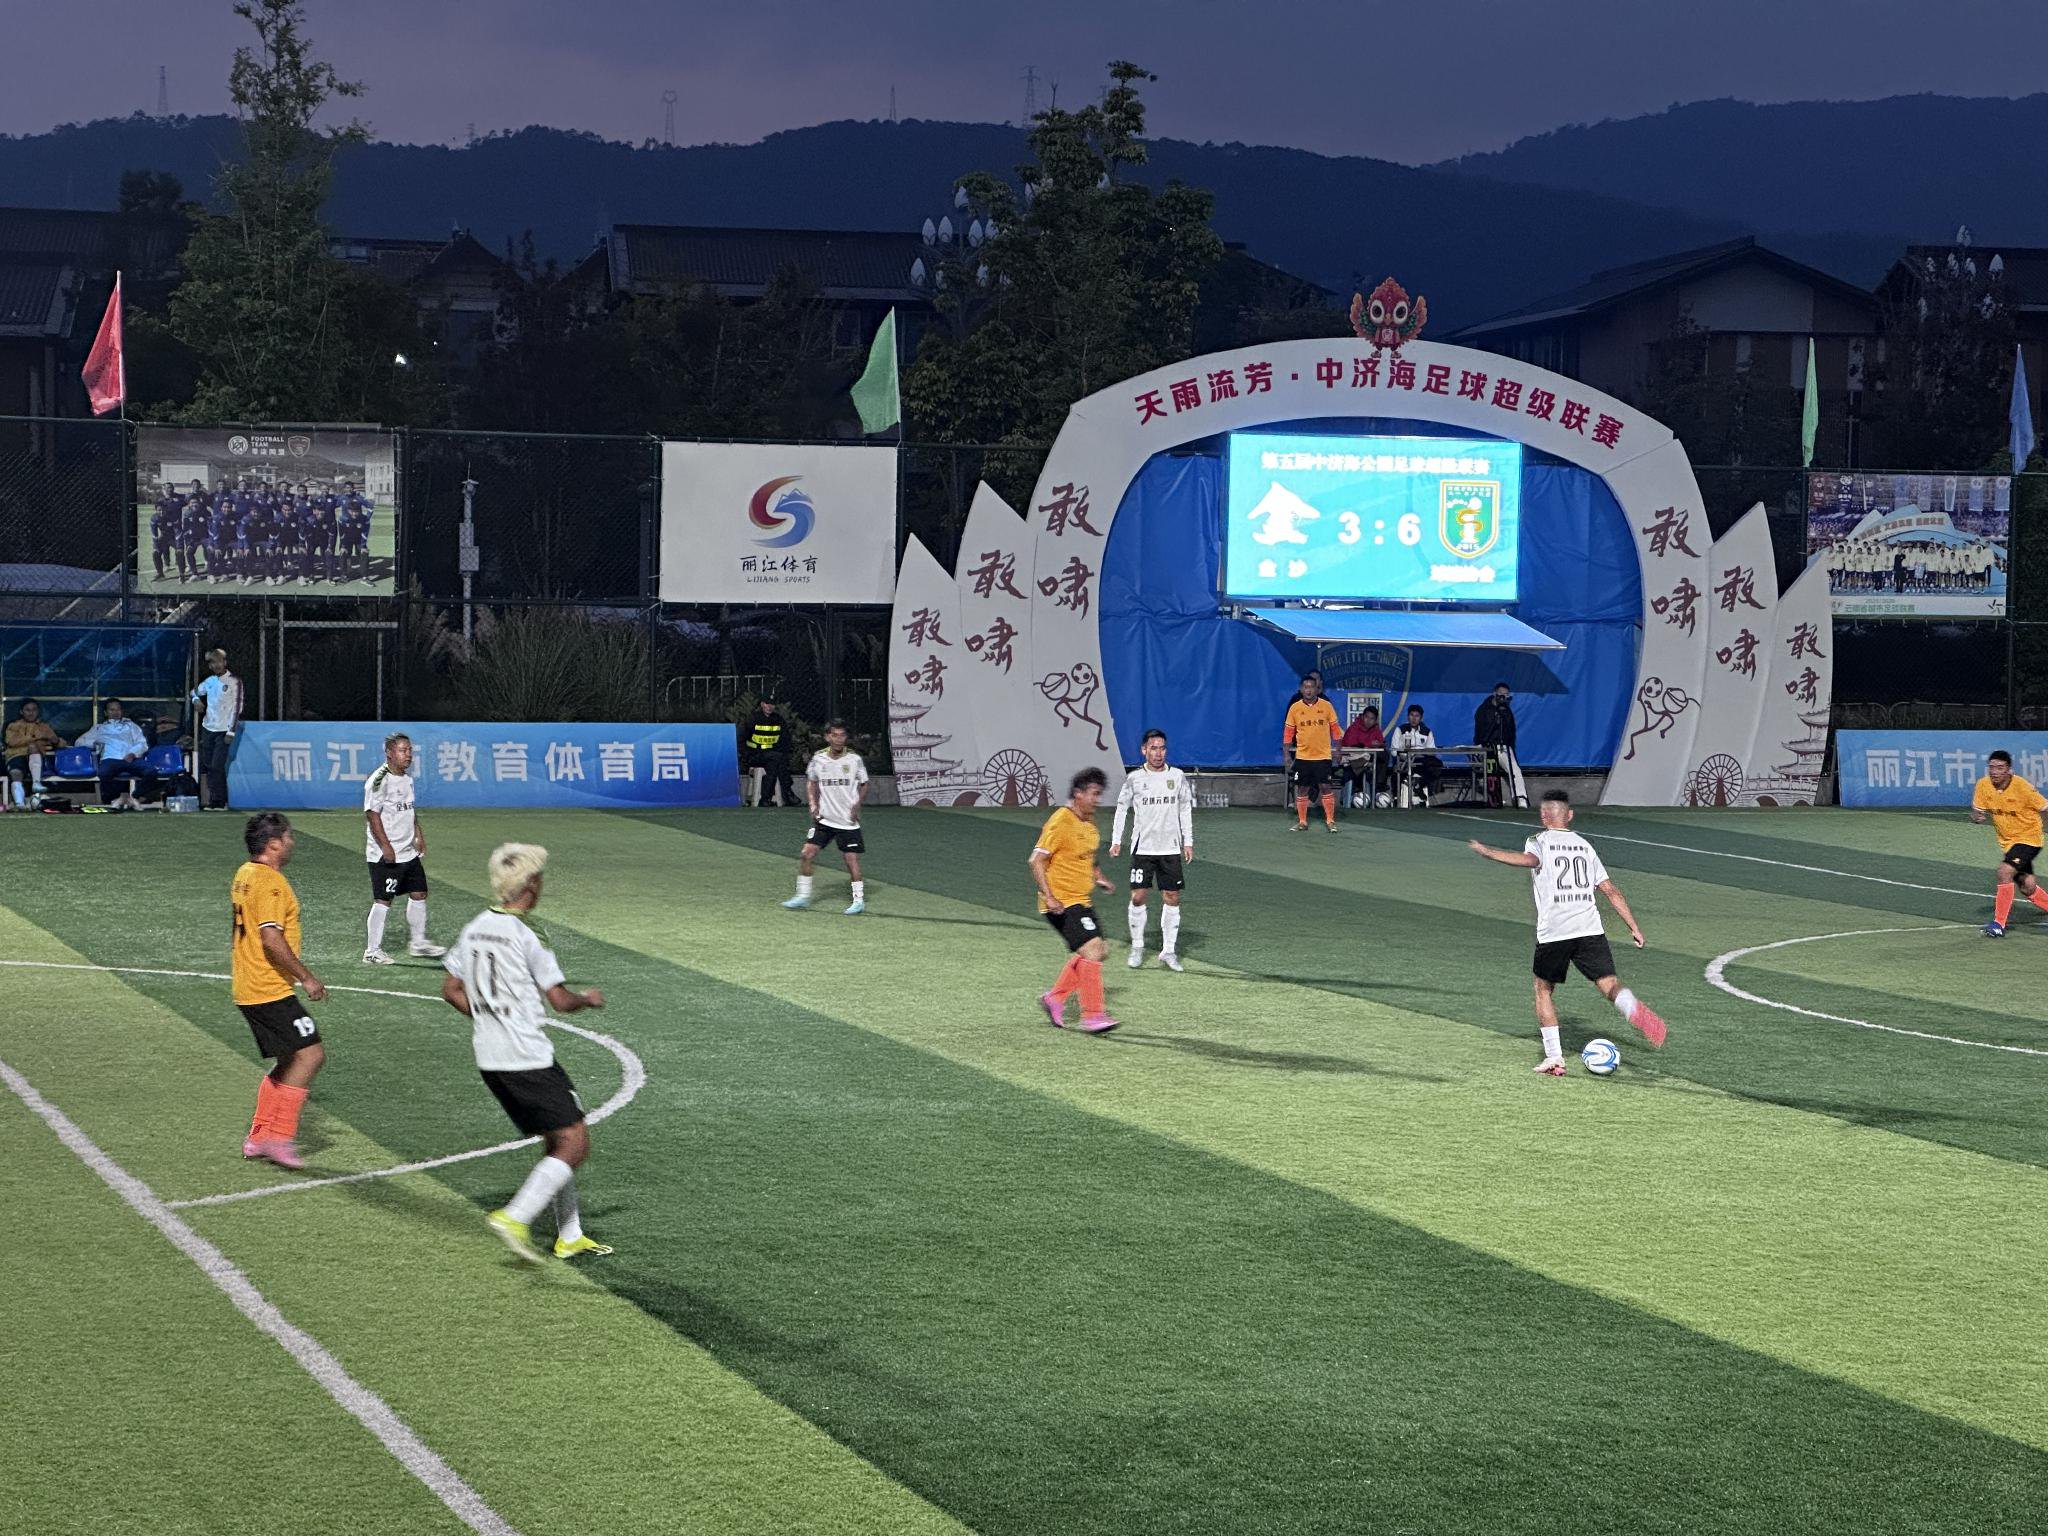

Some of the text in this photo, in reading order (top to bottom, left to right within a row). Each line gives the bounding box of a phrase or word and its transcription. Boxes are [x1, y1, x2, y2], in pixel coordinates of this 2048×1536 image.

[1134, 357, 1624, 450] 天雨流芳·中济海足球超级联赛
[739, 555, 819, 574] 丽江体育
[746, 575, 811, 584] LIJIANG SPORTS
[270, 741, 690, 783] 丽江教育体育局
[1865, 748, 2048, 789] 丽江市城
[385, 878, 398, 893] 22
[1554, 855, 1590, 890] 20
[293, 1016, 316, 1038] 19
